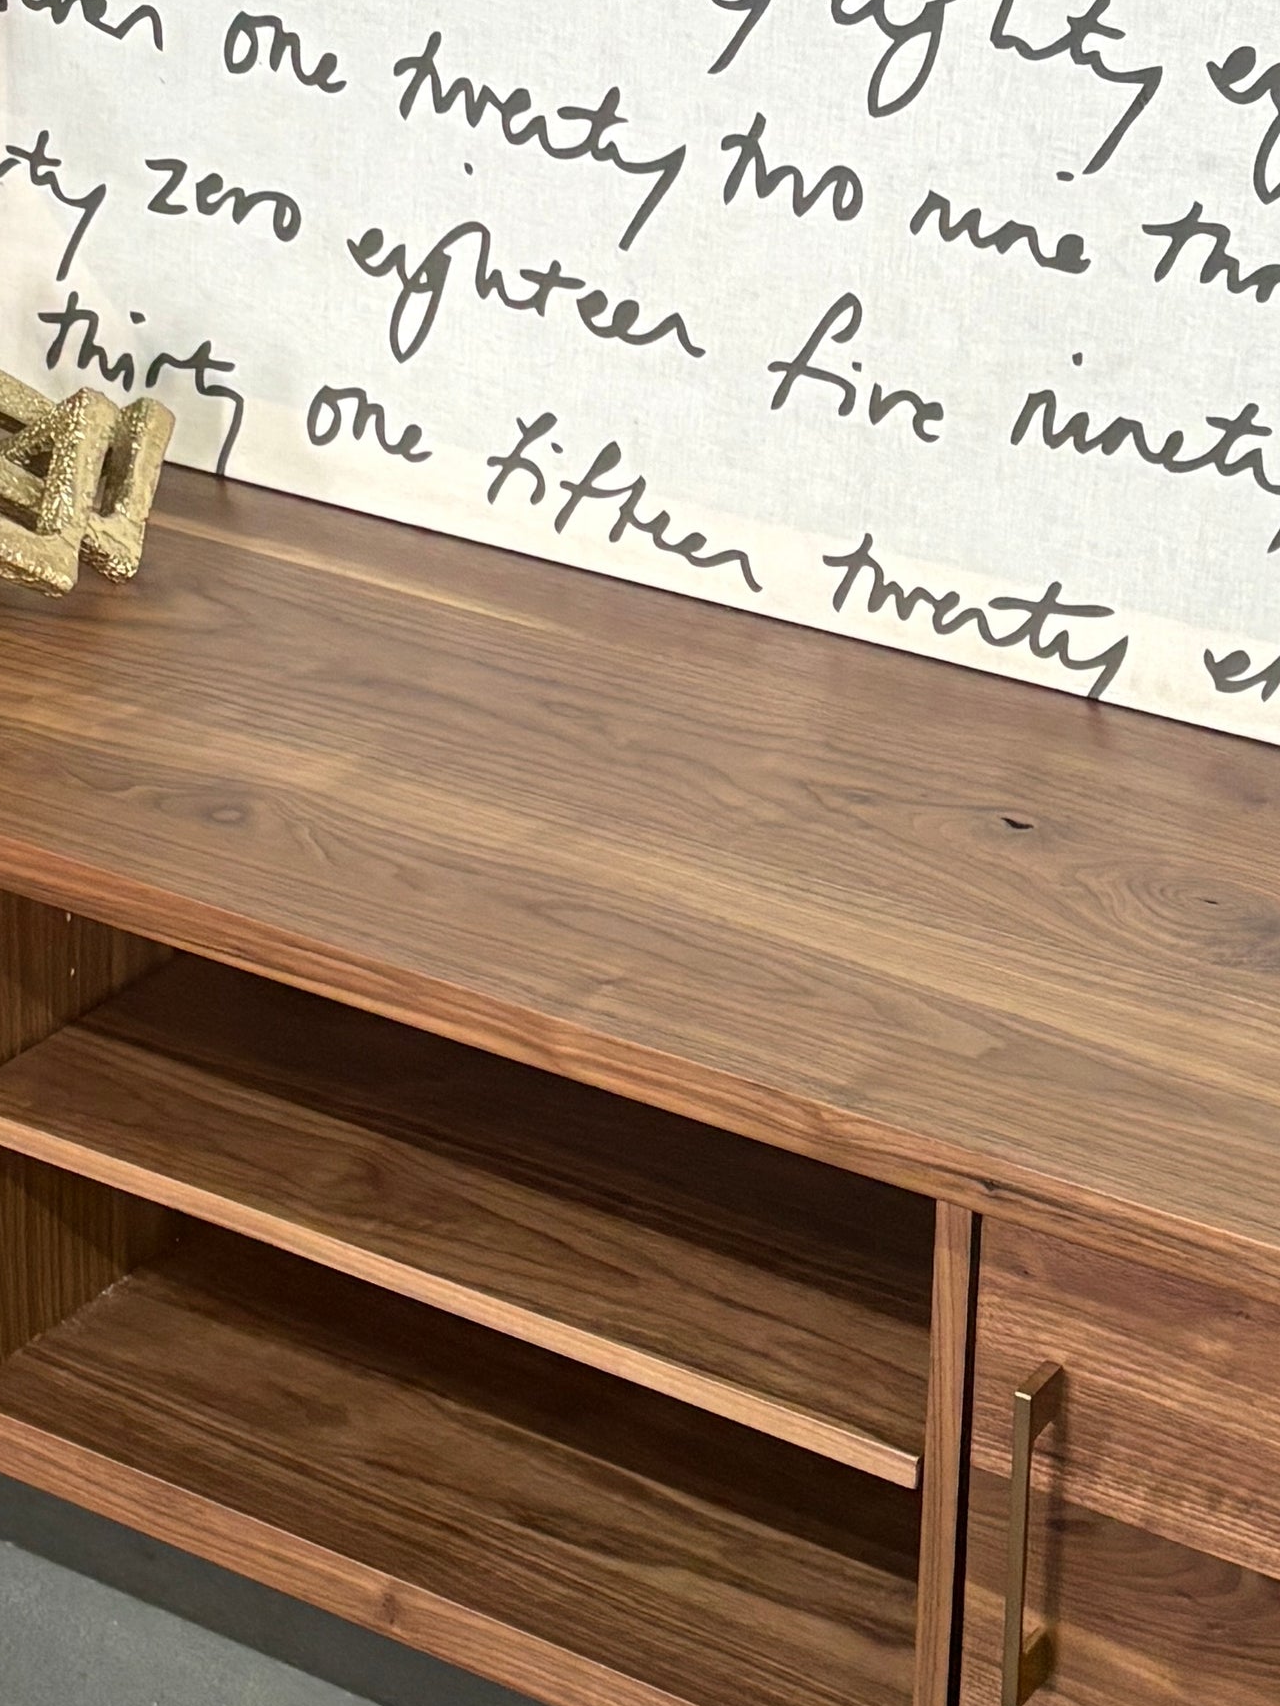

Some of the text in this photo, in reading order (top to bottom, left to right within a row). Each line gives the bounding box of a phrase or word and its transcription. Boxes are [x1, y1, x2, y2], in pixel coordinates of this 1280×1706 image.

[223, 10, 348, 94] one
[392, 30, 687, 251] twenty
[720, 111, 864, 222] two
[908, 172, 1092, 275] nine
[144, 157, 302, 243] zero
[345, 164, 707, 364] eighteen
[767, 291, 945, 444] five
[37, 290, 246, 476] thirty
[306, 384, 432, 462] one
[486, 411, 763, 592] fifteen
[823, 533, 1130, 701] twenty
